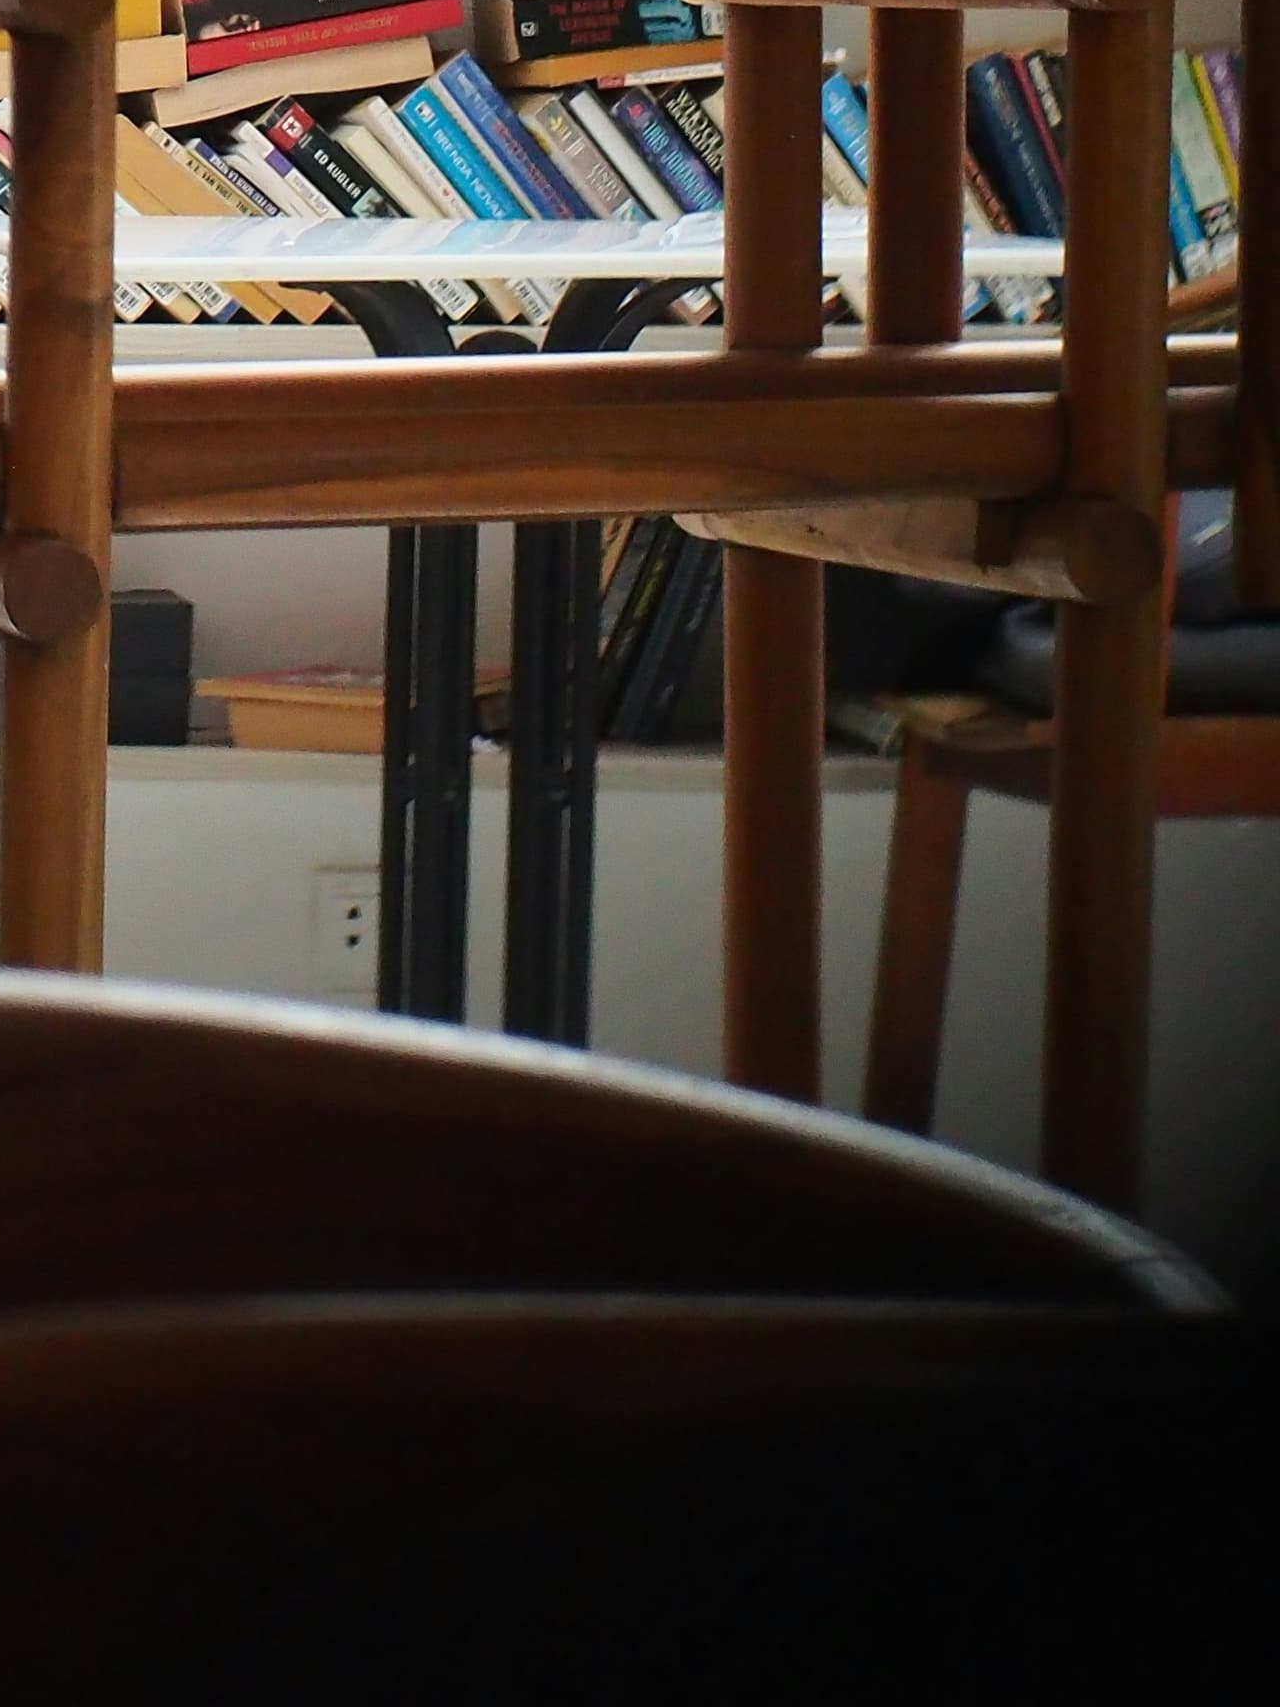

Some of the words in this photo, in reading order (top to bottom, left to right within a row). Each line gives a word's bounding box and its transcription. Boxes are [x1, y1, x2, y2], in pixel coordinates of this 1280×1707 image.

[312, 149, 333, 169] ED
[329, 163, 362, 198] KUGLER
[432, 128, 474, 176] BRENDA
[470, 173, 507, 219] NOVA
